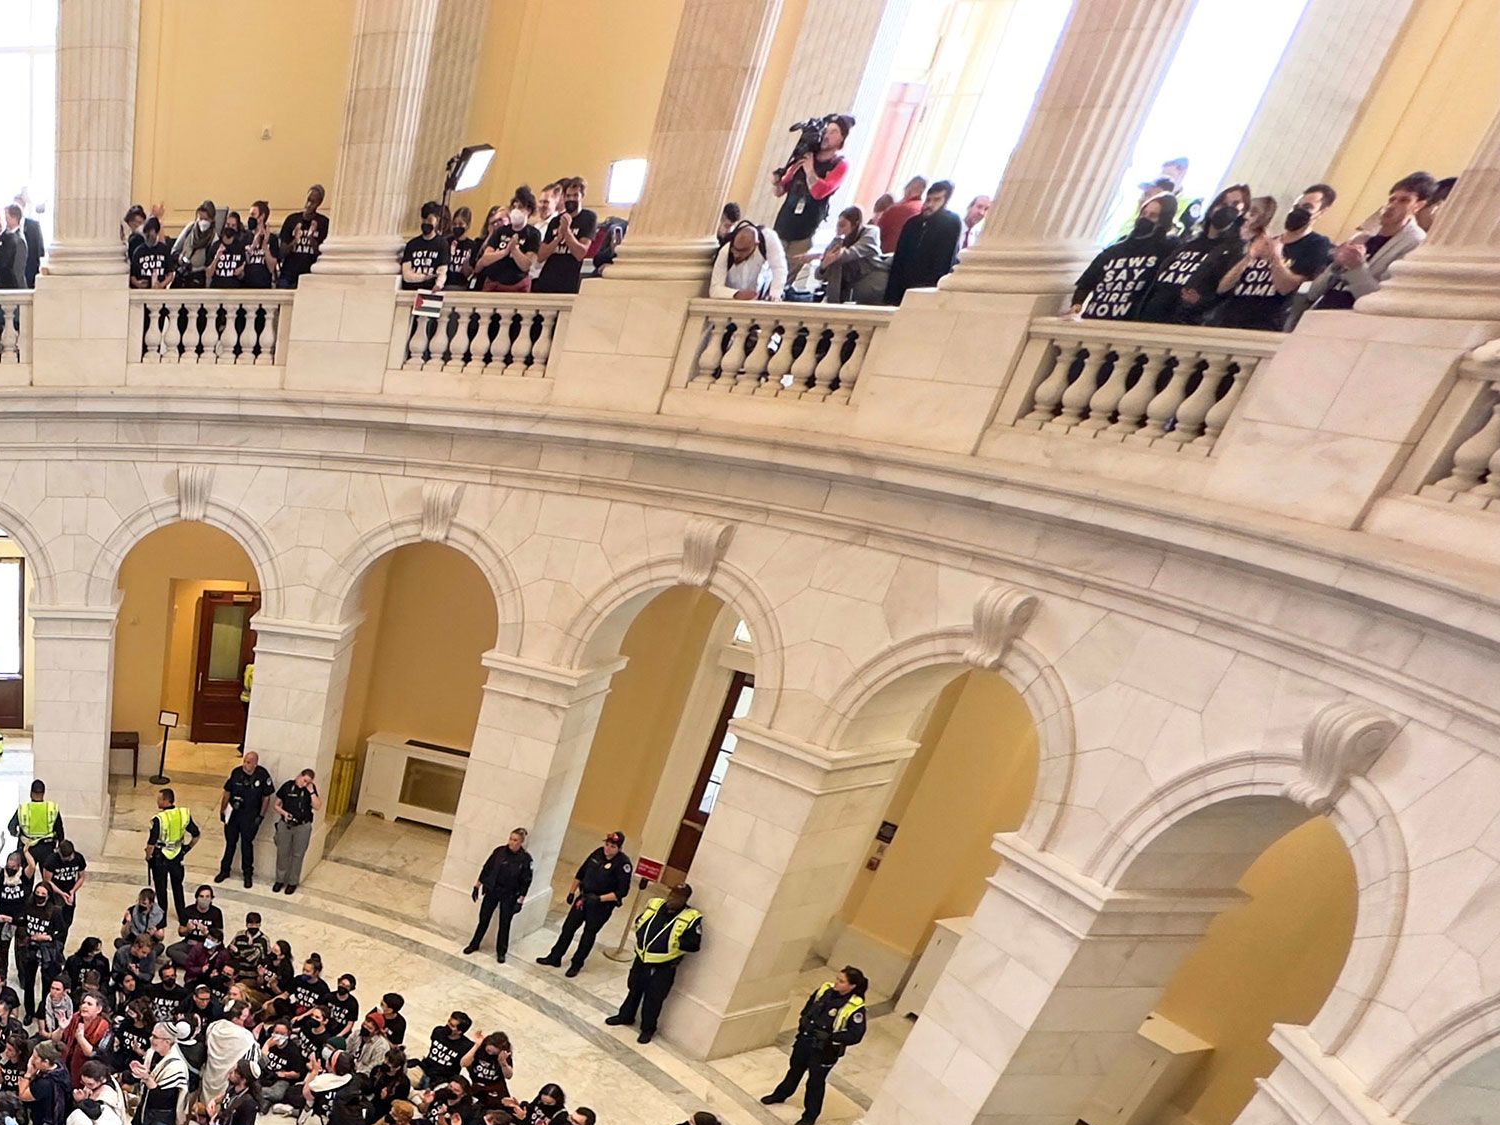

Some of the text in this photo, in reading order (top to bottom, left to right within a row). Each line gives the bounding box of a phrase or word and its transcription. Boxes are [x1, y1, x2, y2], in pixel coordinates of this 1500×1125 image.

[218, 261, 237, 269] OUR
[1103, 256, 1157, 270] JEWS
[1103, 268, 1145, 282] SAY
[4, 885, 20, 894] OUR
[1, 890, 24, 900] NAME
